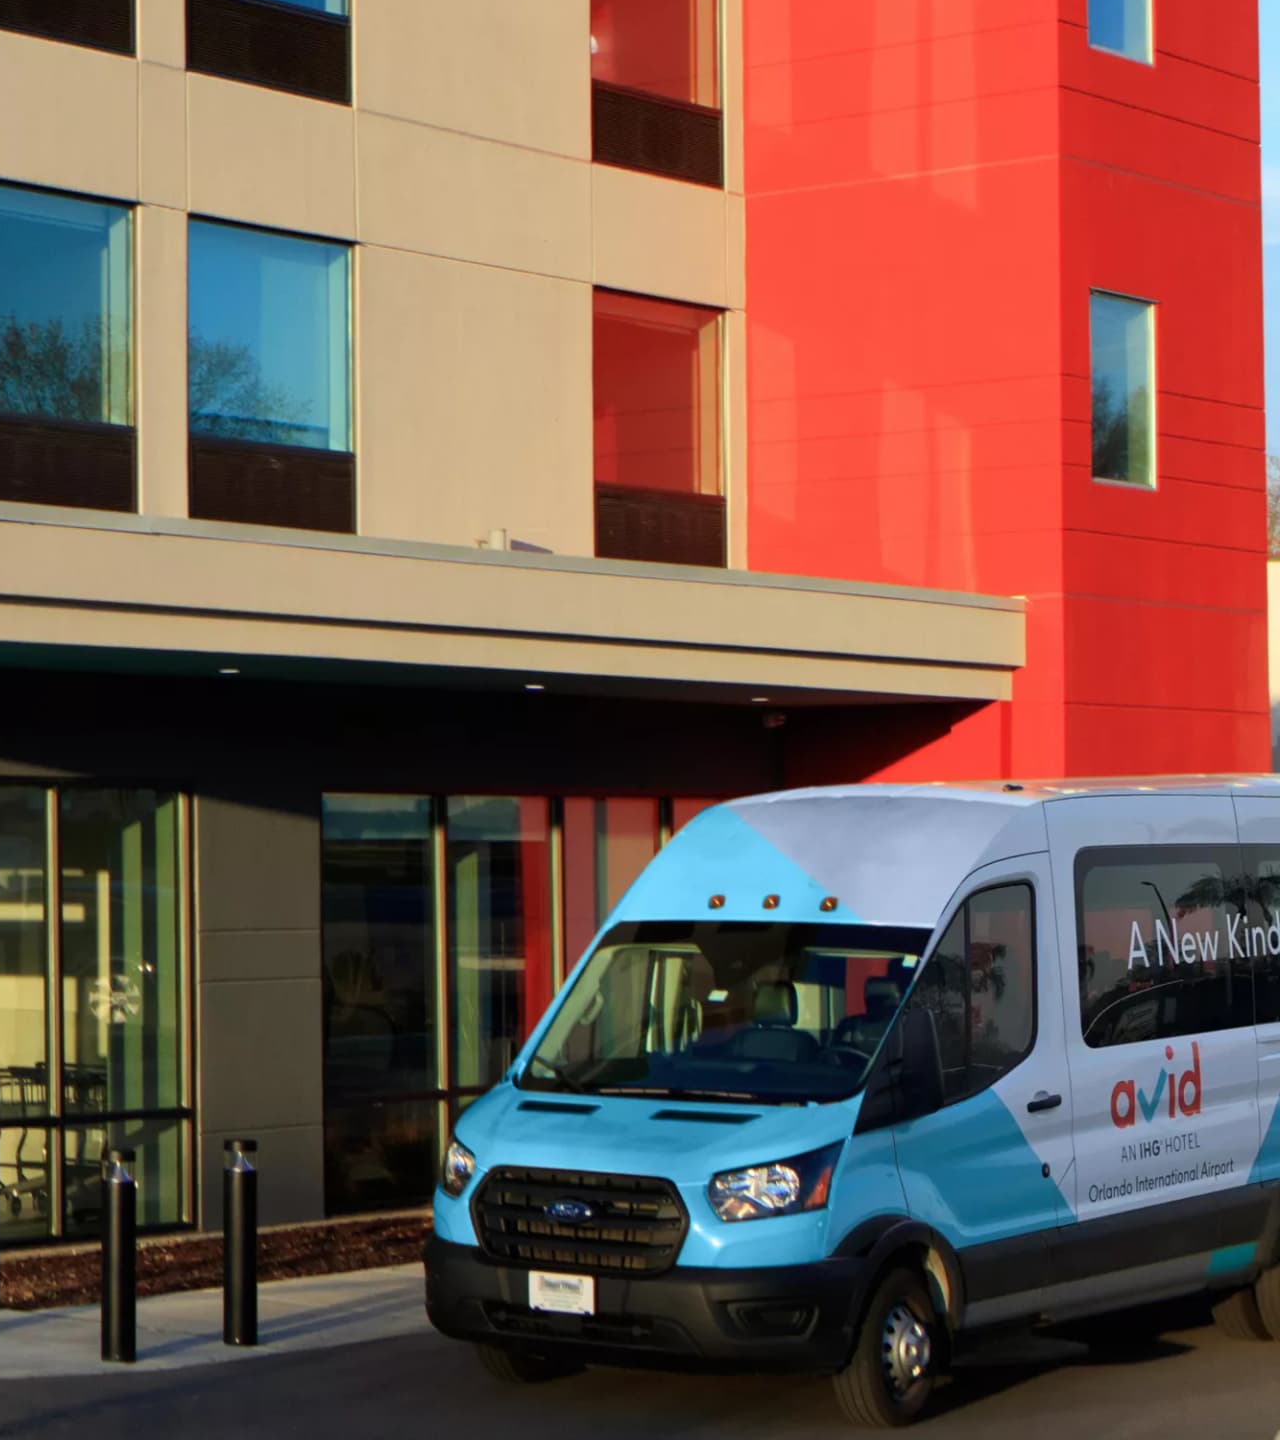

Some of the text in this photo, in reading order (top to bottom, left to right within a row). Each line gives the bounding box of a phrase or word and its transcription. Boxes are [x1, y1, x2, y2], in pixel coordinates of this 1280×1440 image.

[1127, 909, 1280, 970] A New Kind
[1110, 1041, 1203, 1129] avid
[1121, 1143, 1137, 1163] AN
[1165, 1132, 1201, 1155] HOTEL
[1088, 1157, 1235, 1203] Orlando International Airport
